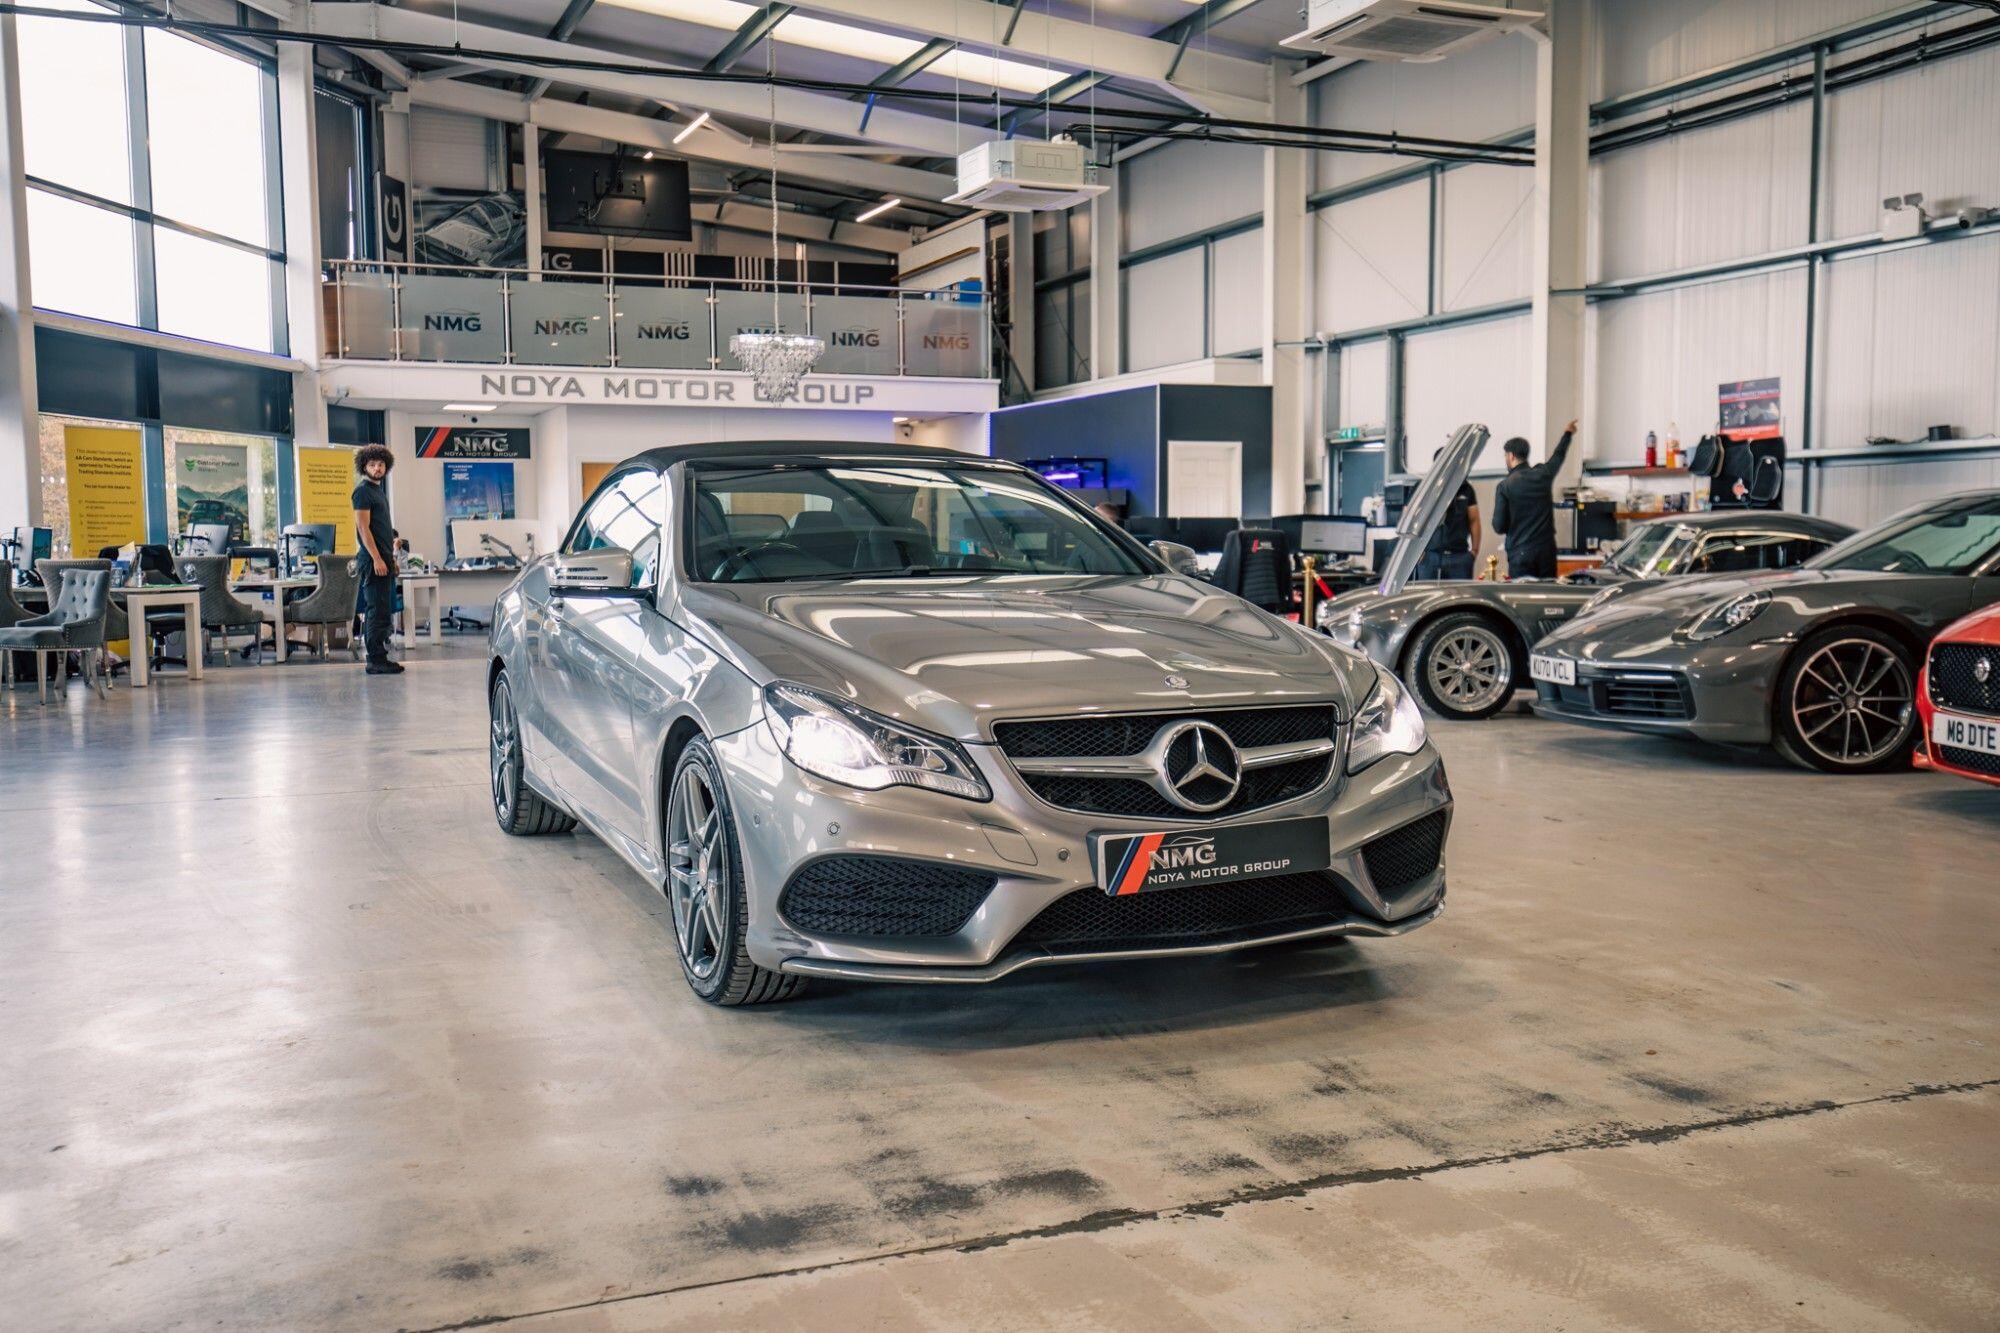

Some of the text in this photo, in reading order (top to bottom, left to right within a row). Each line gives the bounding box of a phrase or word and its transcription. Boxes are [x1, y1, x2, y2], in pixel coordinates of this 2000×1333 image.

[424, 315, 482, 332] NMG
[534, 320, 588, 335] NMG
[637, 325, 690, 340] NMG
[831, 332, 880, 347] NMG
[923, 335, 970, 350] NMG
[481, 374, 585, 397] NOYA
[604, 378, 735, 401] MOTOR
[453, 436, 509, 452] NMG
[1947, 719, 1997, 750] M8 DTE
[1148, 844, 1216, 870] NMG
[1148, 859, 1290, 885] NOYA MOTOR GROUP
